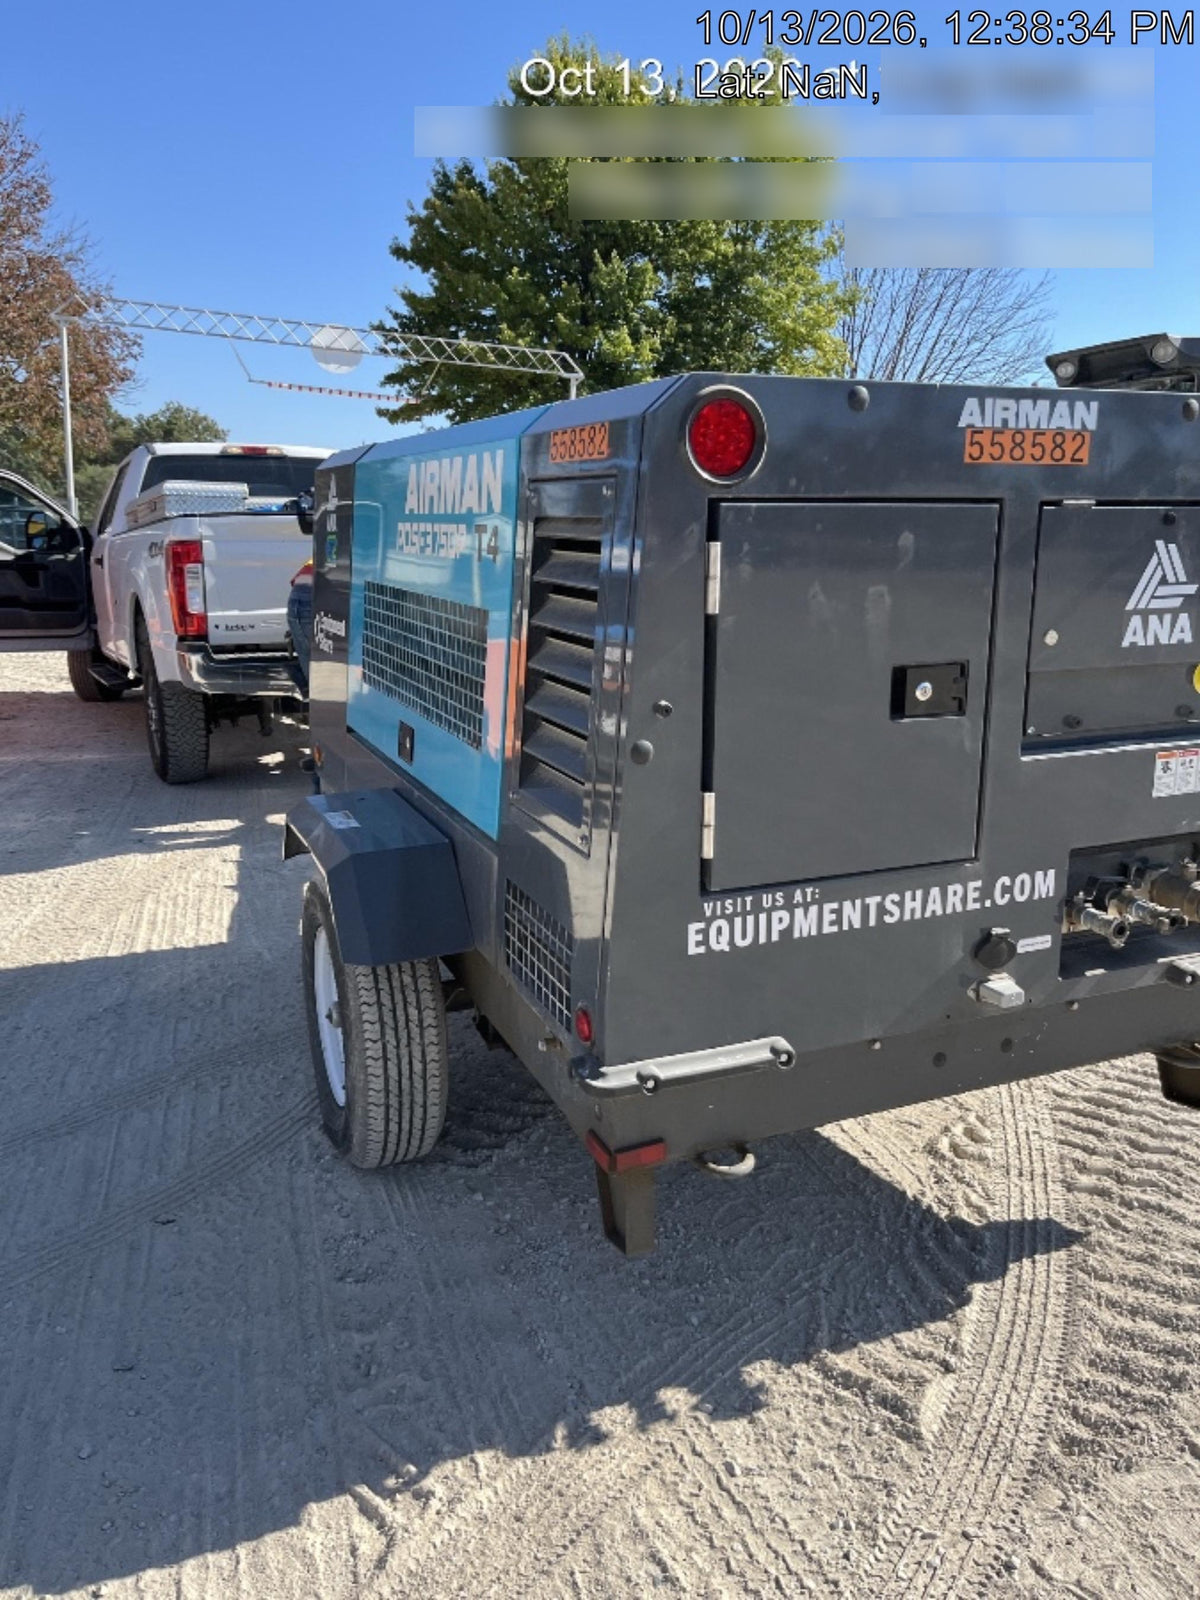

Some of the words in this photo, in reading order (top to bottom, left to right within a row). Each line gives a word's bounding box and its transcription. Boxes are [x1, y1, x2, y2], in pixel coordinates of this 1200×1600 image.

[957, 397, 1099, 431] AIRMAN
[550, 422, 608, 461] 558582
[968, 430, 1086, 463] 558582
[404, 449, 504, 515] AIRMAN
[474, 523, 499, 563] T4
[1121, 612, 1193, 648] ANA
[687, 868, 1056, 956] EQUIPMENTSHARE.COM
[704, 895, 753, 917] VISIT
[762, 892, 785, 909] US
[792, 886, 821, 904] AT:
